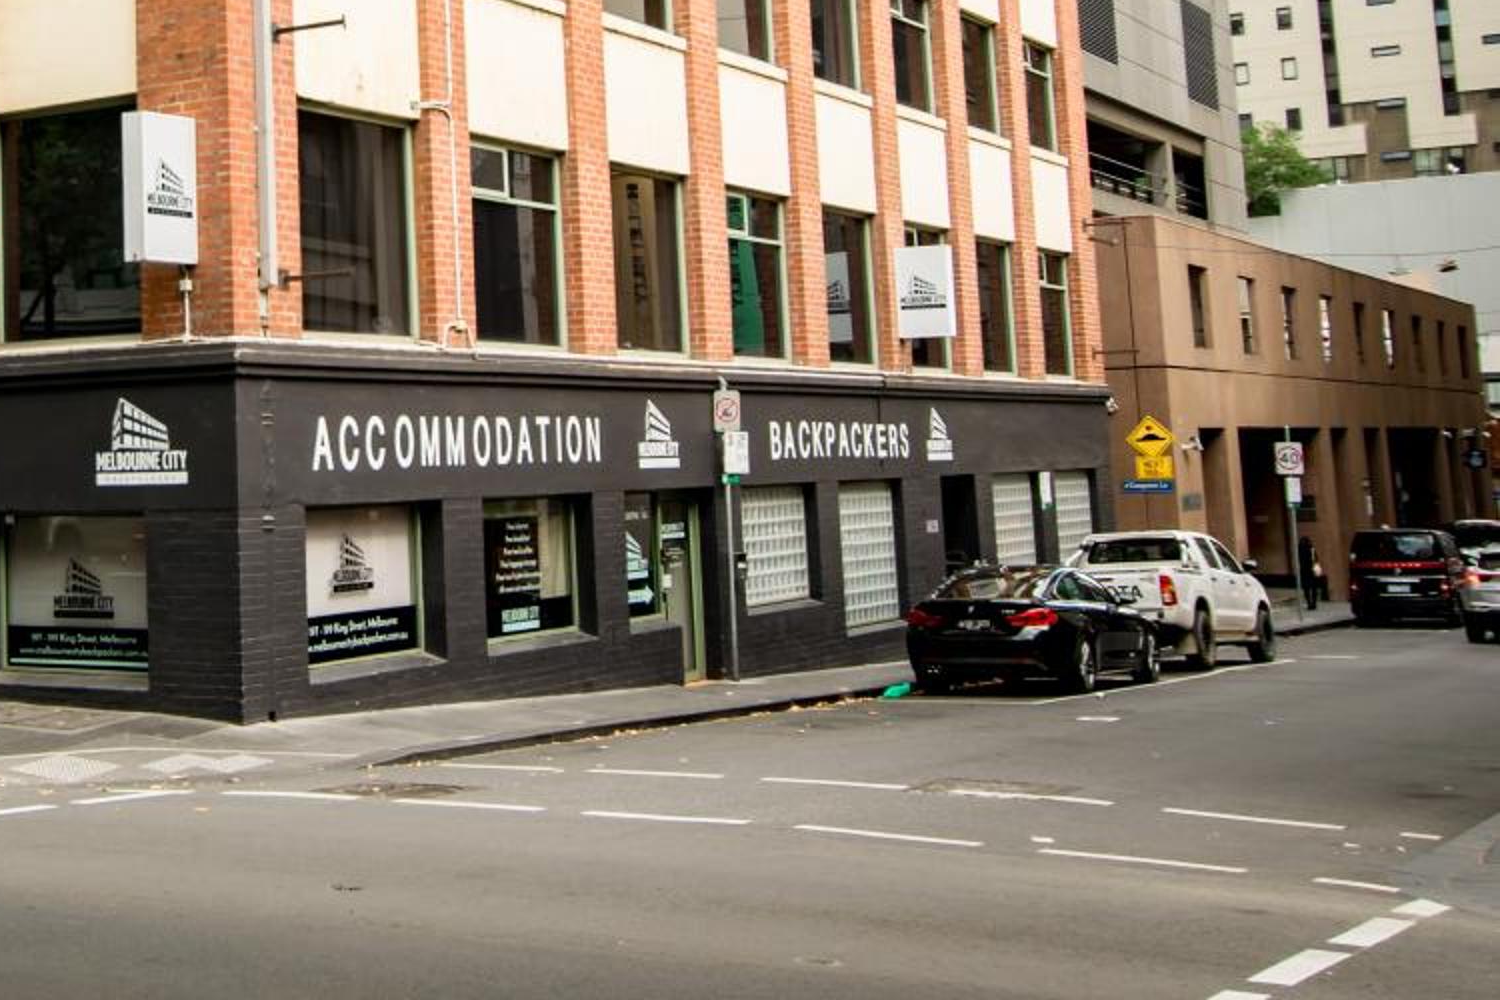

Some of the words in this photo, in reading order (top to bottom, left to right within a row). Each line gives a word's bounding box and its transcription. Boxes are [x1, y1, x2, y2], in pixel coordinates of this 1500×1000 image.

[312, 414, 601, 471] ACCOMMODATION
[769, 420, 909, 460] BACKPACKERS
[96, 451, 161, 471] MELBOURNE
[162, 449, 187, 469] CITY
[1281, 450, 1300, 465] 40
